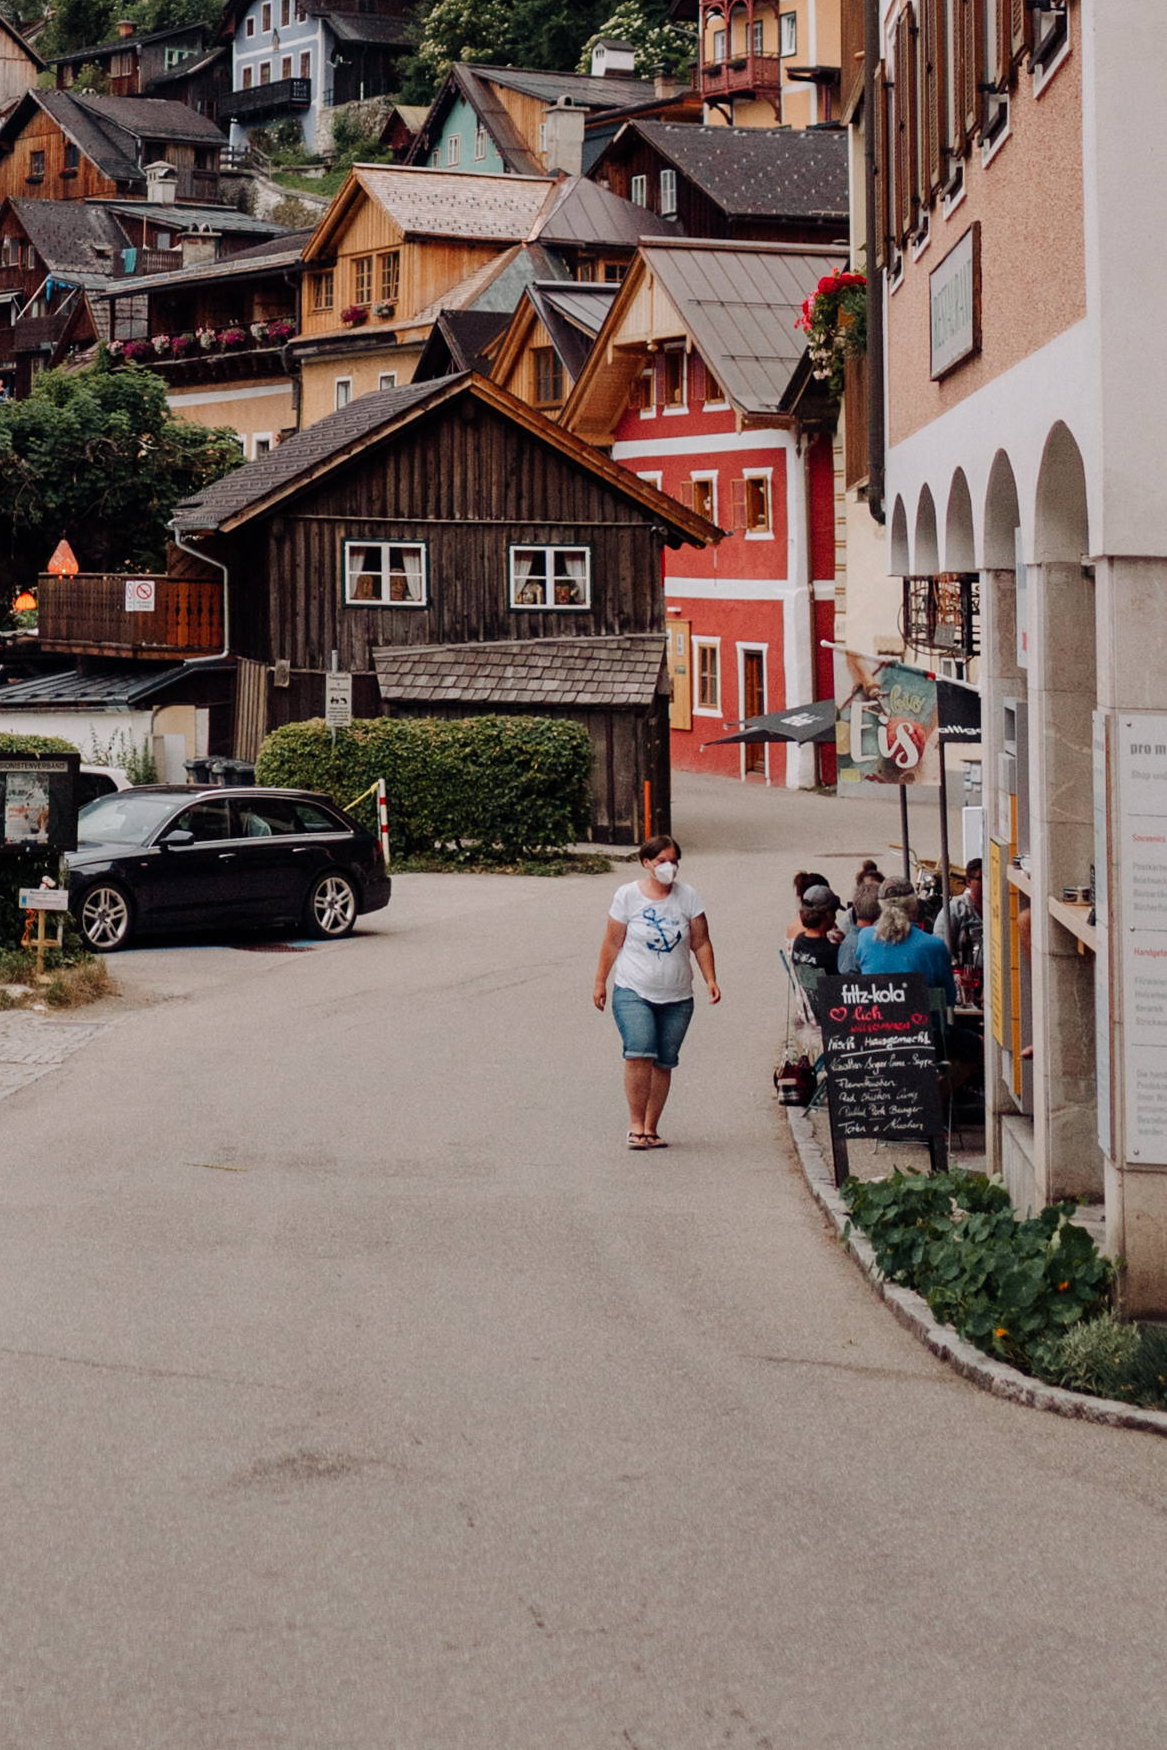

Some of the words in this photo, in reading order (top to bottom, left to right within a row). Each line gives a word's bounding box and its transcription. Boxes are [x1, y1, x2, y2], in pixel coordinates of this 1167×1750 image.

[889, 684, 925, 714] bio
[850, 700, 919, 769] Eis
[1130, 743, 1152, 756] pro
[841, 983, 905, 1004] fritz-kola
